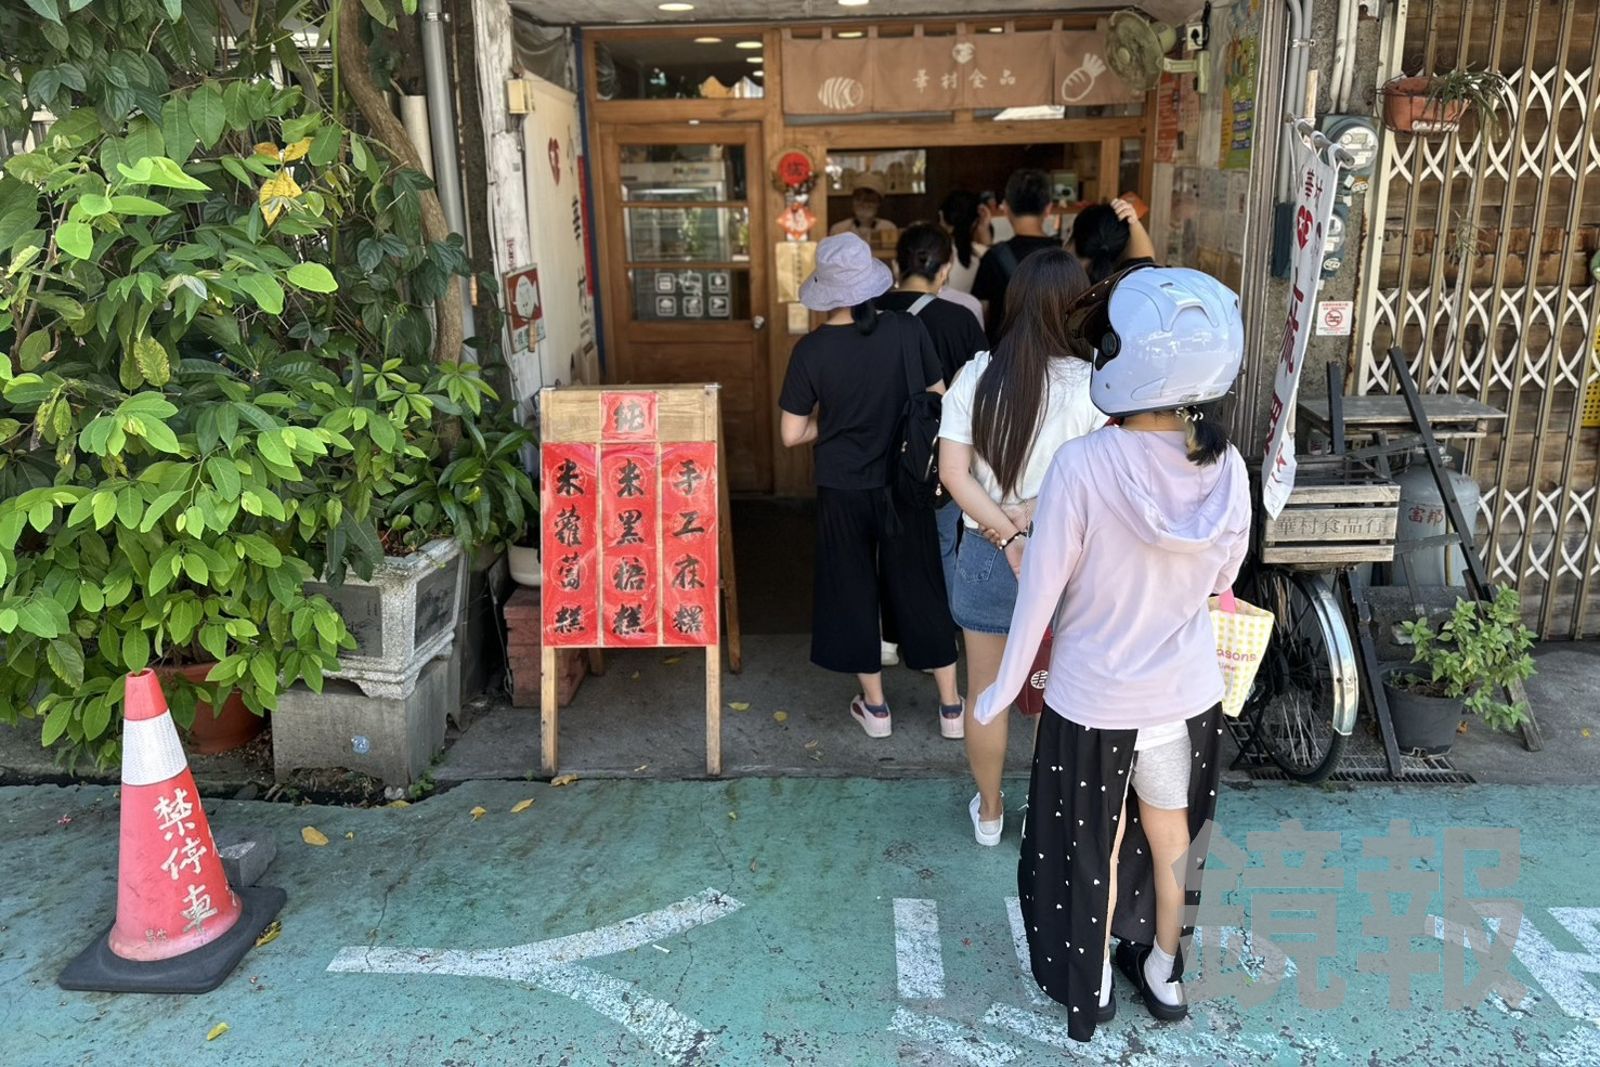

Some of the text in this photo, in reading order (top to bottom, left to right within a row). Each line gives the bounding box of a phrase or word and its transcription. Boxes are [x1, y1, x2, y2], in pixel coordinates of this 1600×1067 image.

[912, 68, 1017, 93] 華村食品
[553, 458, 585, 635] 米蘿蔔糕
[612, 458, 646, 636] 米黑糖糕
[671, 459, 705, 634] 手工麻糬
[1276, 515, 1388, 536] 華村食品行
[1408, 505, 1444, 526] 富邦
[153, 787, 218, 935] 禁停車
